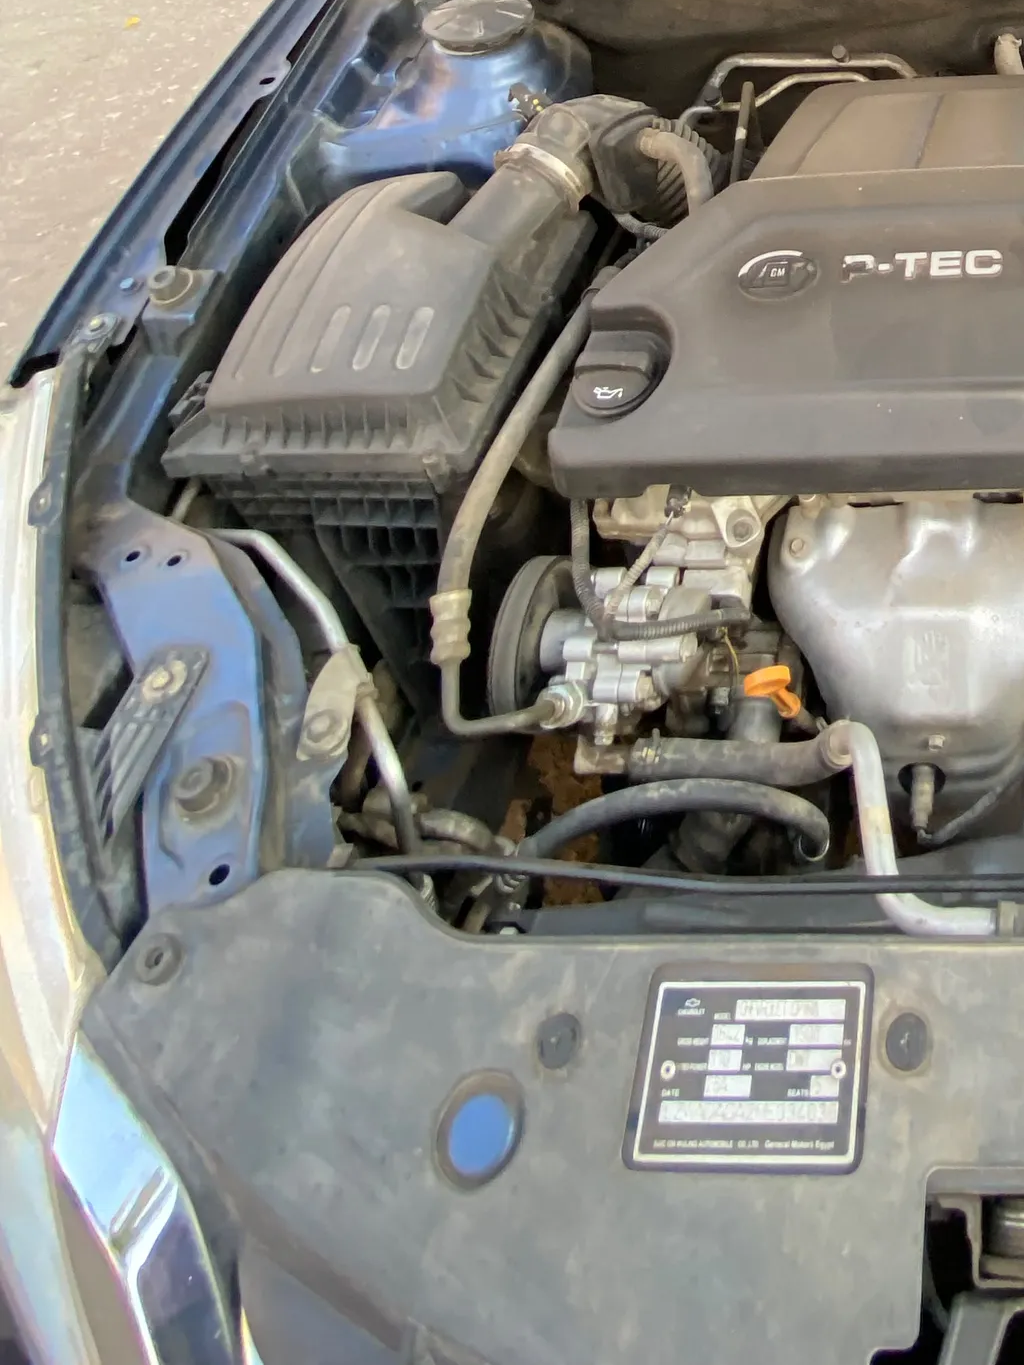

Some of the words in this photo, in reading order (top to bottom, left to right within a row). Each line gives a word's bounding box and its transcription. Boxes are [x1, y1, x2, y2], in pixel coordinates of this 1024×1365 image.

[770, 266, 785, 278] GM
[841, 249, 1003, 284] P-TEC
[661, 1088, 680, 1097] DATE
[787, 1088, 809, 1098] SEATS
